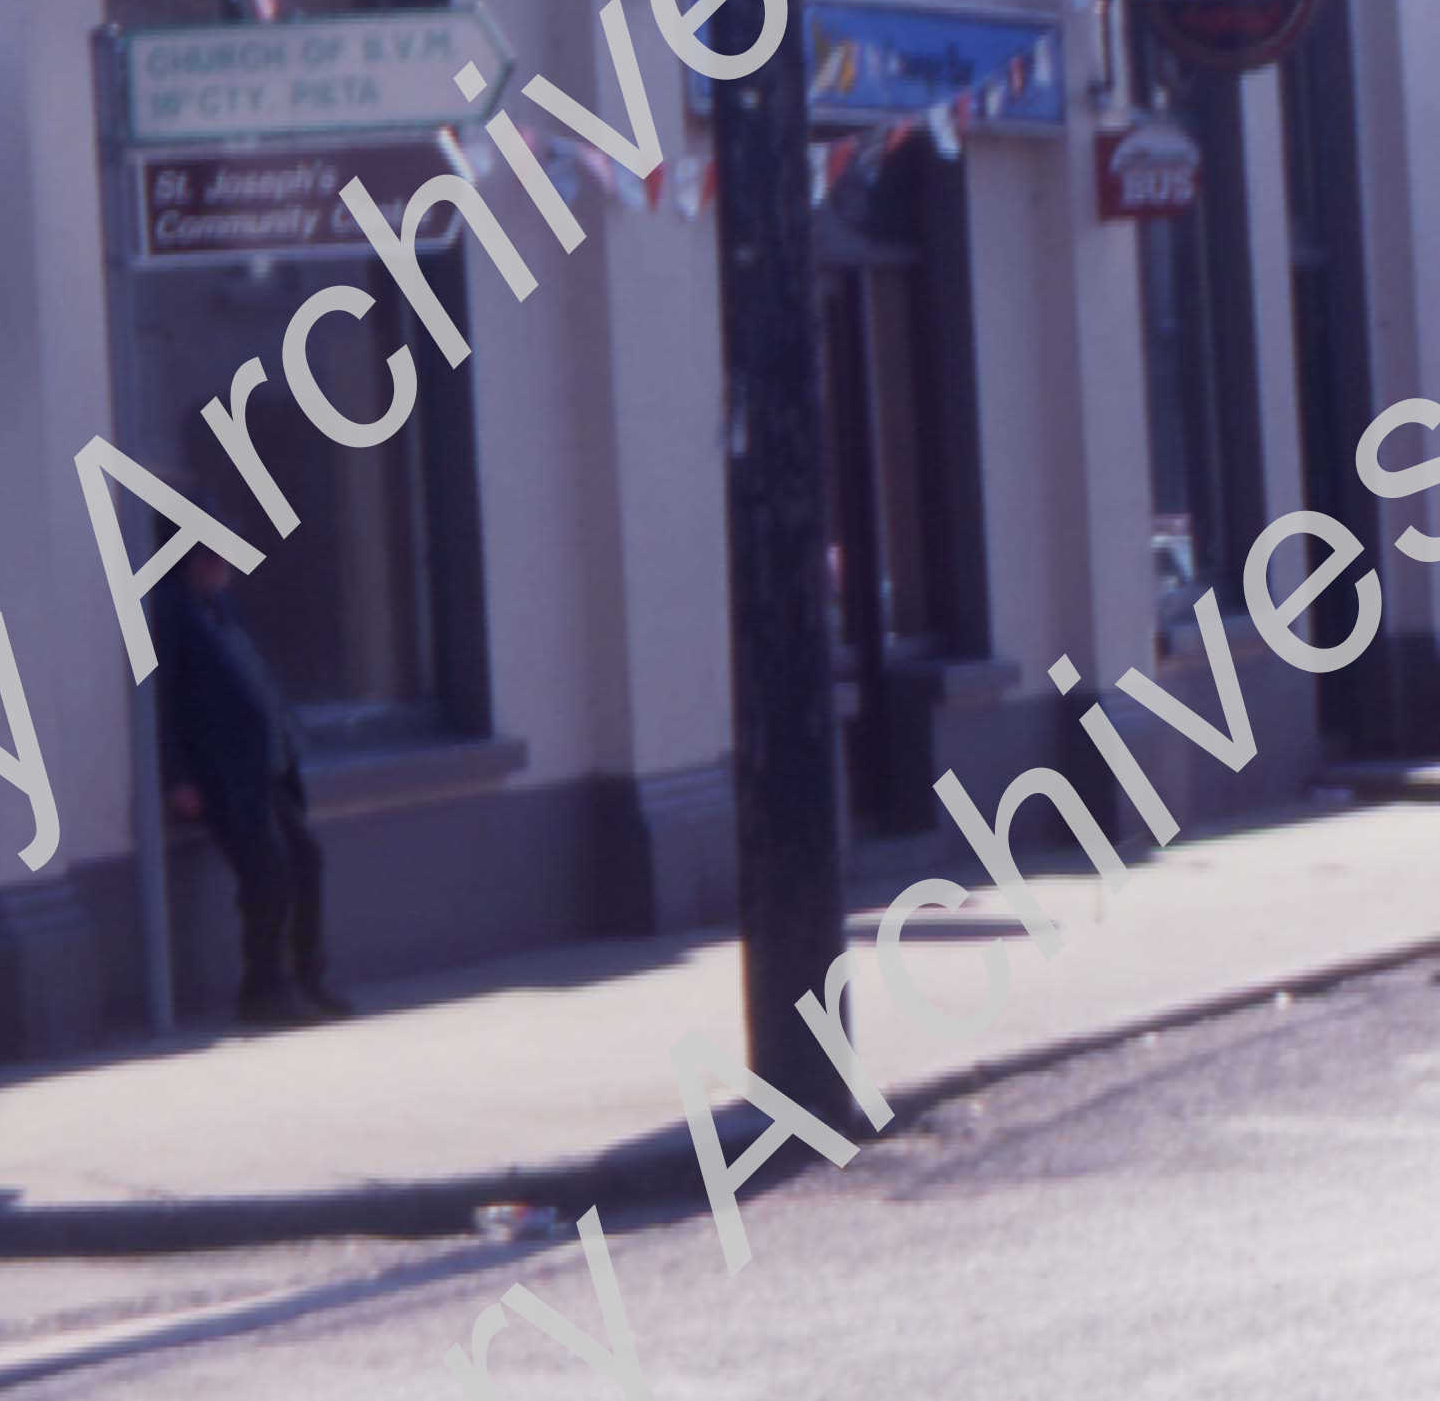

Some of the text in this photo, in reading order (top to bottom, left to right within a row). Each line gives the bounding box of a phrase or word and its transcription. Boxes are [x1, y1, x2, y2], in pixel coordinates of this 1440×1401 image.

[146, 42, 287, 79] CHURCH
[301, 35, 345, 71] OF
[203, 158, 338, 204] Joseph's
[1122, 167, 1195, 204] BUS
[153, 201, 320, 244] Community
